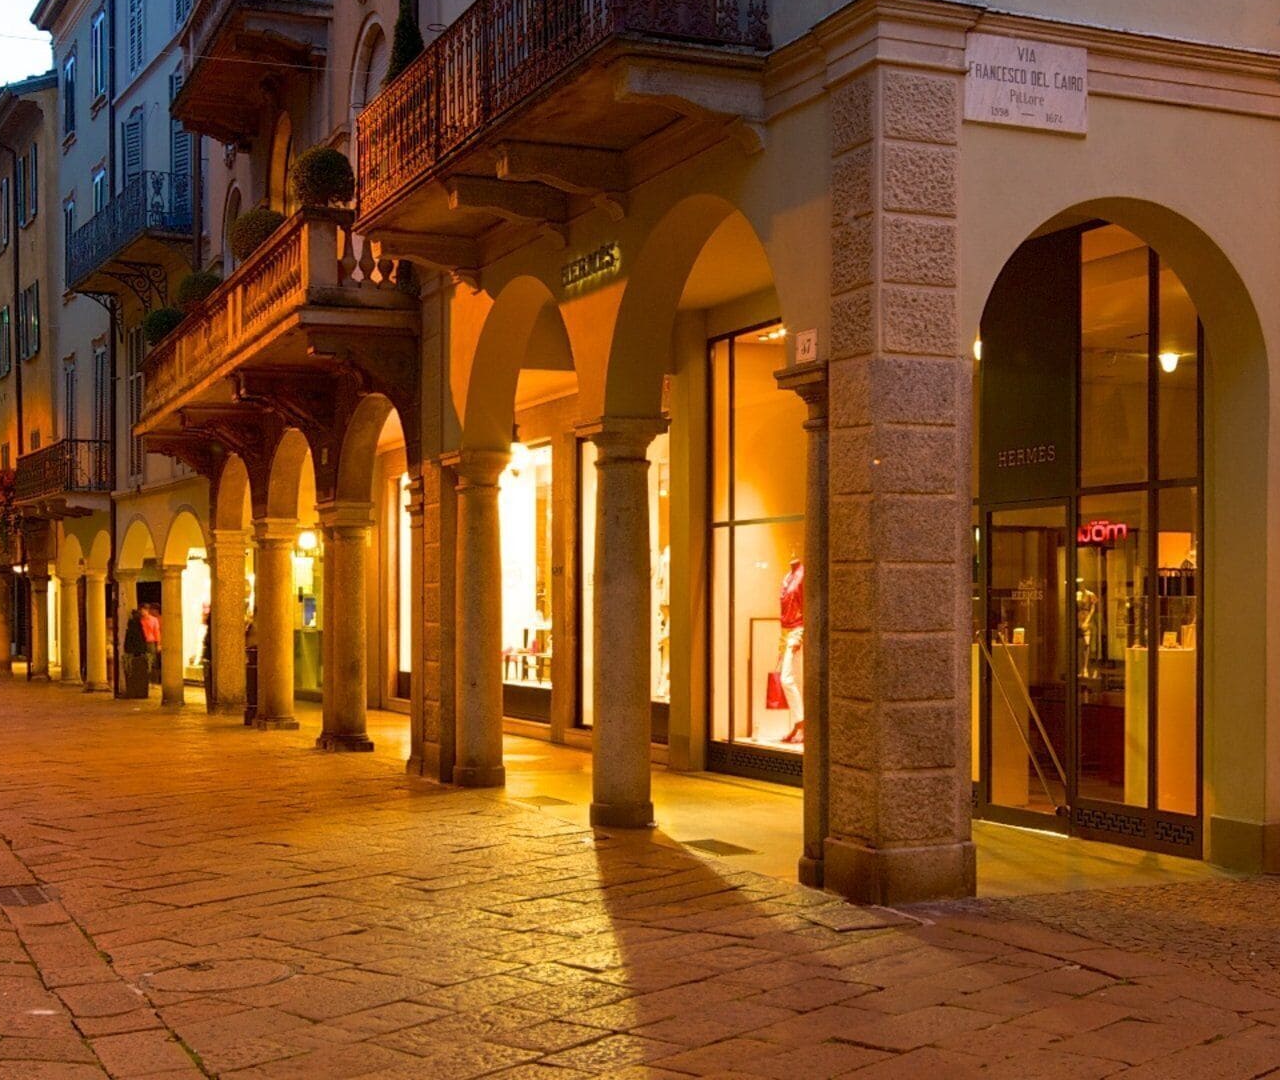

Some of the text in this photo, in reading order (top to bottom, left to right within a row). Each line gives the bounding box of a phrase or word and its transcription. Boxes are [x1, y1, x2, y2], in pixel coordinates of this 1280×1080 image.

[1017, 46, 1037, 64] VIA
[968, 61, 1084, 92] FRANCESCO DEL CAIRO
